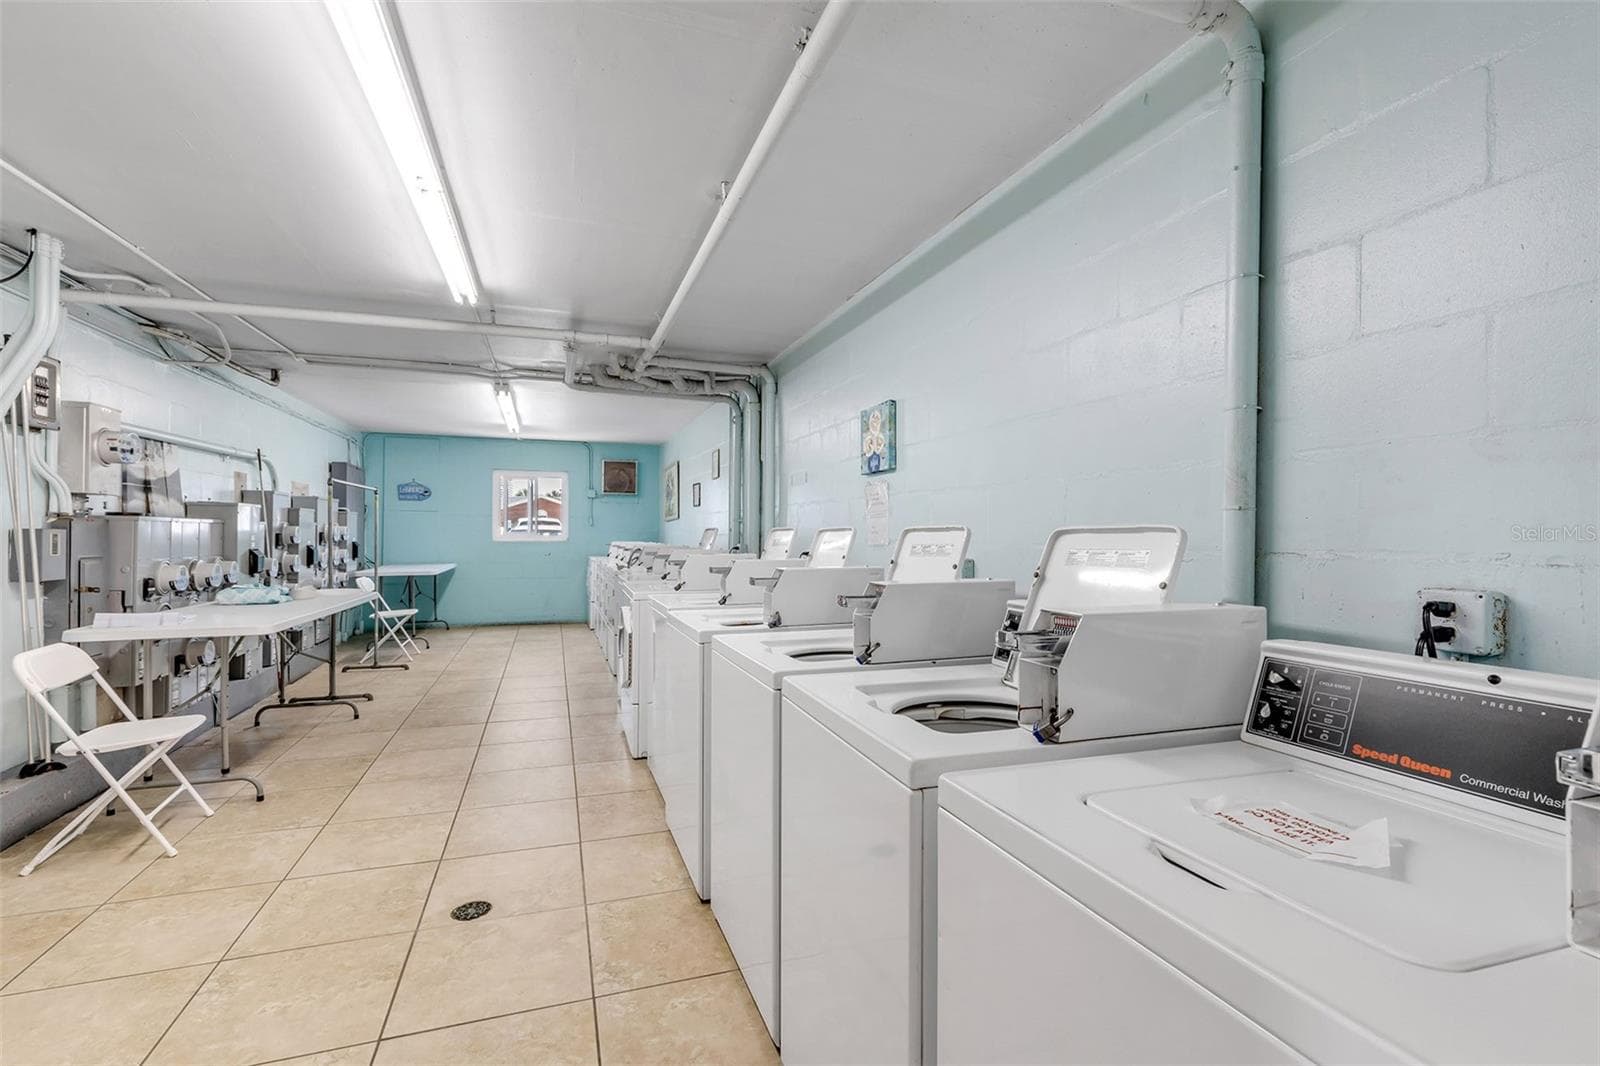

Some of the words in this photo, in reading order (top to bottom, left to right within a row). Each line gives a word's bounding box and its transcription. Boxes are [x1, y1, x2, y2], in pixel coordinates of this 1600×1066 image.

[1396, 685, 1466, 702] PERMANENT
[1481, 700, 1523, 713] PRESS
[1352, 743, 1398, 765] Speed
[1400, 755, 1453, 780] Queen
[1459, 773, 1530, 800] Commercial
